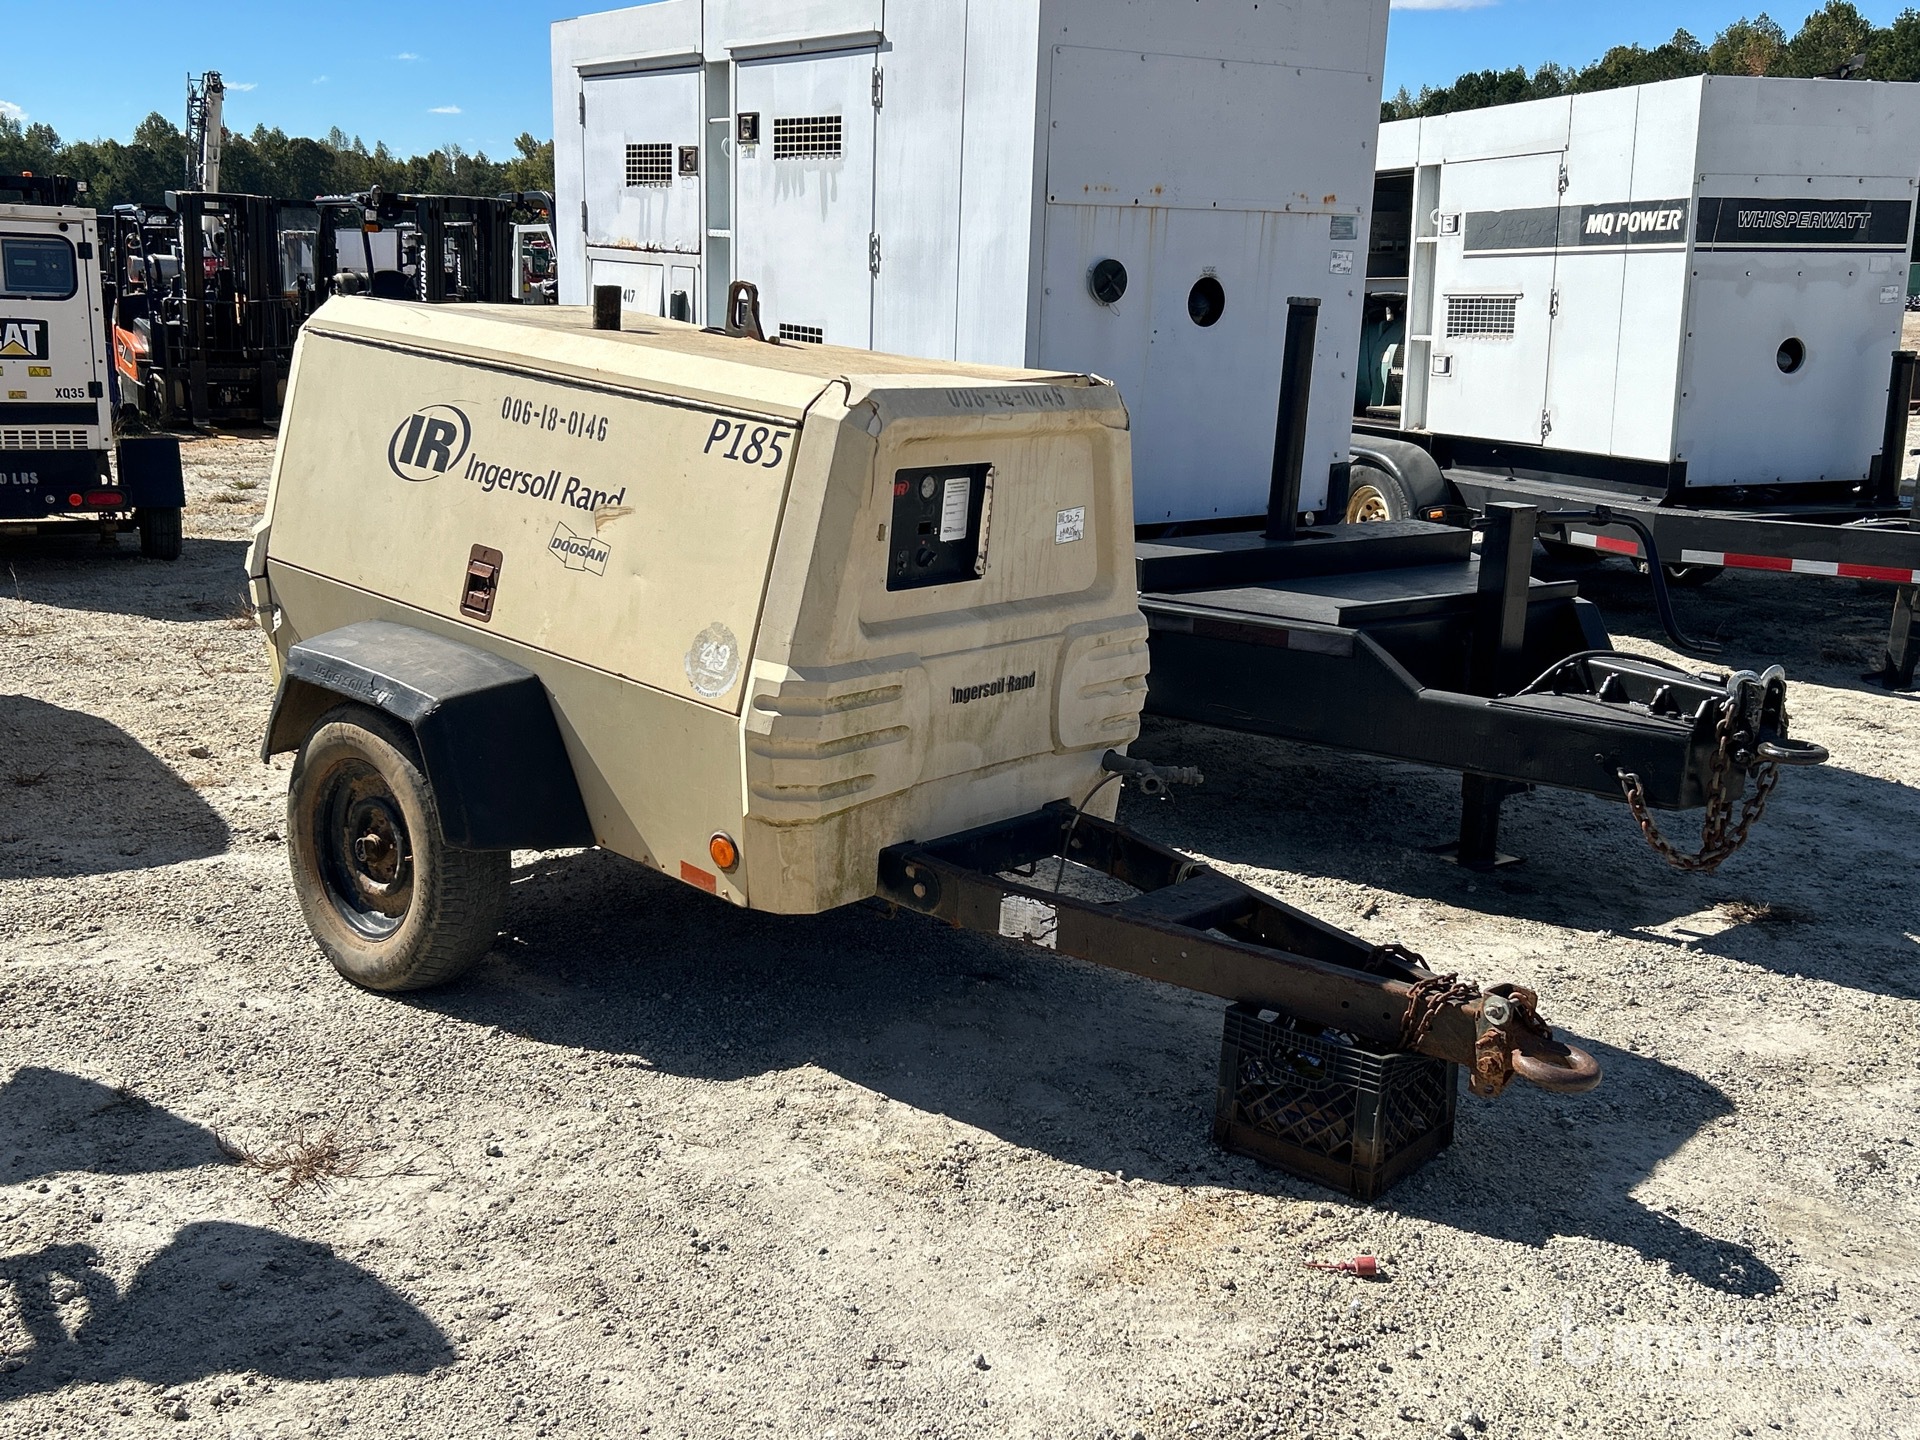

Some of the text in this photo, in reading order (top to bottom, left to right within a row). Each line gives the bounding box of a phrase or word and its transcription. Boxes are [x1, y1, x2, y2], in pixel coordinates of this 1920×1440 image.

[1585, 209, 1682, 236] MQ POWER
[1738, 210, 1872, 229] WHISPERWATT
[0, 323, 40, 356] AT
[55, 387, 85, 399] XQ35
[501, 396, 609, 442] 006-18-0146
[398, 413, 458, 474] IR
[703, 418, 791, 469] P185
[12, 472, 39, 485] LBS
[464, 453, 562, 501] Ingersoll
[550, 537, 608, 563] DOOSAN
